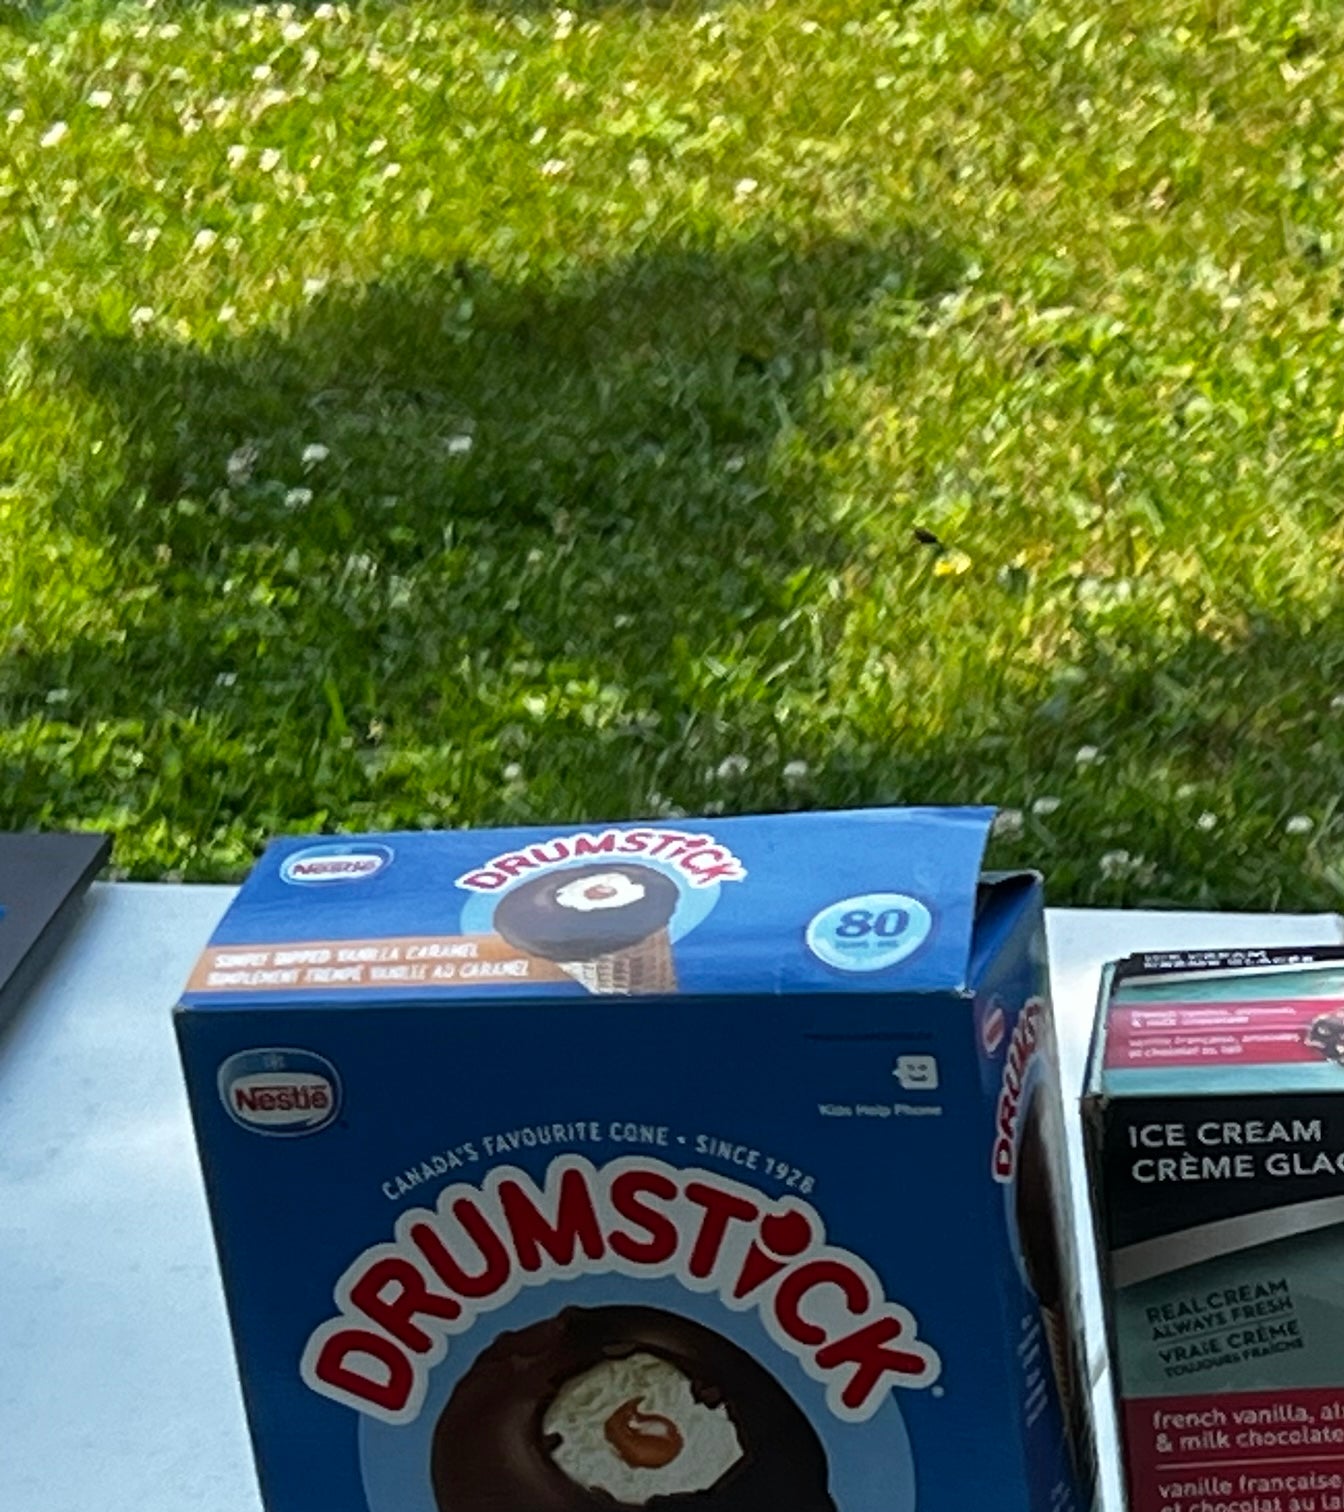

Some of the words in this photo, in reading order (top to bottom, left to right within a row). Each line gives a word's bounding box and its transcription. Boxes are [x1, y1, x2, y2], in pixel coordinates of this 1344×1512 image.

[459, 830, 745, 890] DRUMSTICK
[836, 908, 909, 937] 80
[1128, 1124, 1187, 1149] ICE
[1197, 1119, 1323, 1145] CREAM
[381, 1142, 480, 1202] CANADA'S
[481, 1120, 603, 1159] FAVOURITE
[608, 1121, 670, 1147] CONE
[694, 1133, 759, 1171] SINCE
[764, 1155, 816, 1195] 1928
[1131, 1152, 1256, 1184] CRÈME
[310, 1161, 934, 1418] DRUMSTICK
[1145, 1297, 1206, 1325] REAL
[1205, 1278, 1289, 1310] CREAM
[1151, 1310, 1228, 1341] ALWAYS
[1230, 1295, 1294, 1323] FRESH
[1158, 1338, 1222, 1364] VRAIE
[1153, 1407, 1227, 1431] french
[1233, 1401, 1316, 1425] vanilla,
[1155, 1432, 1174, 1454] &
[1179, 1429, 1231, 1450] milk
[1157, 1476, 1234, 1499] vanille
[1288, 1496, 1317, 1512] au
